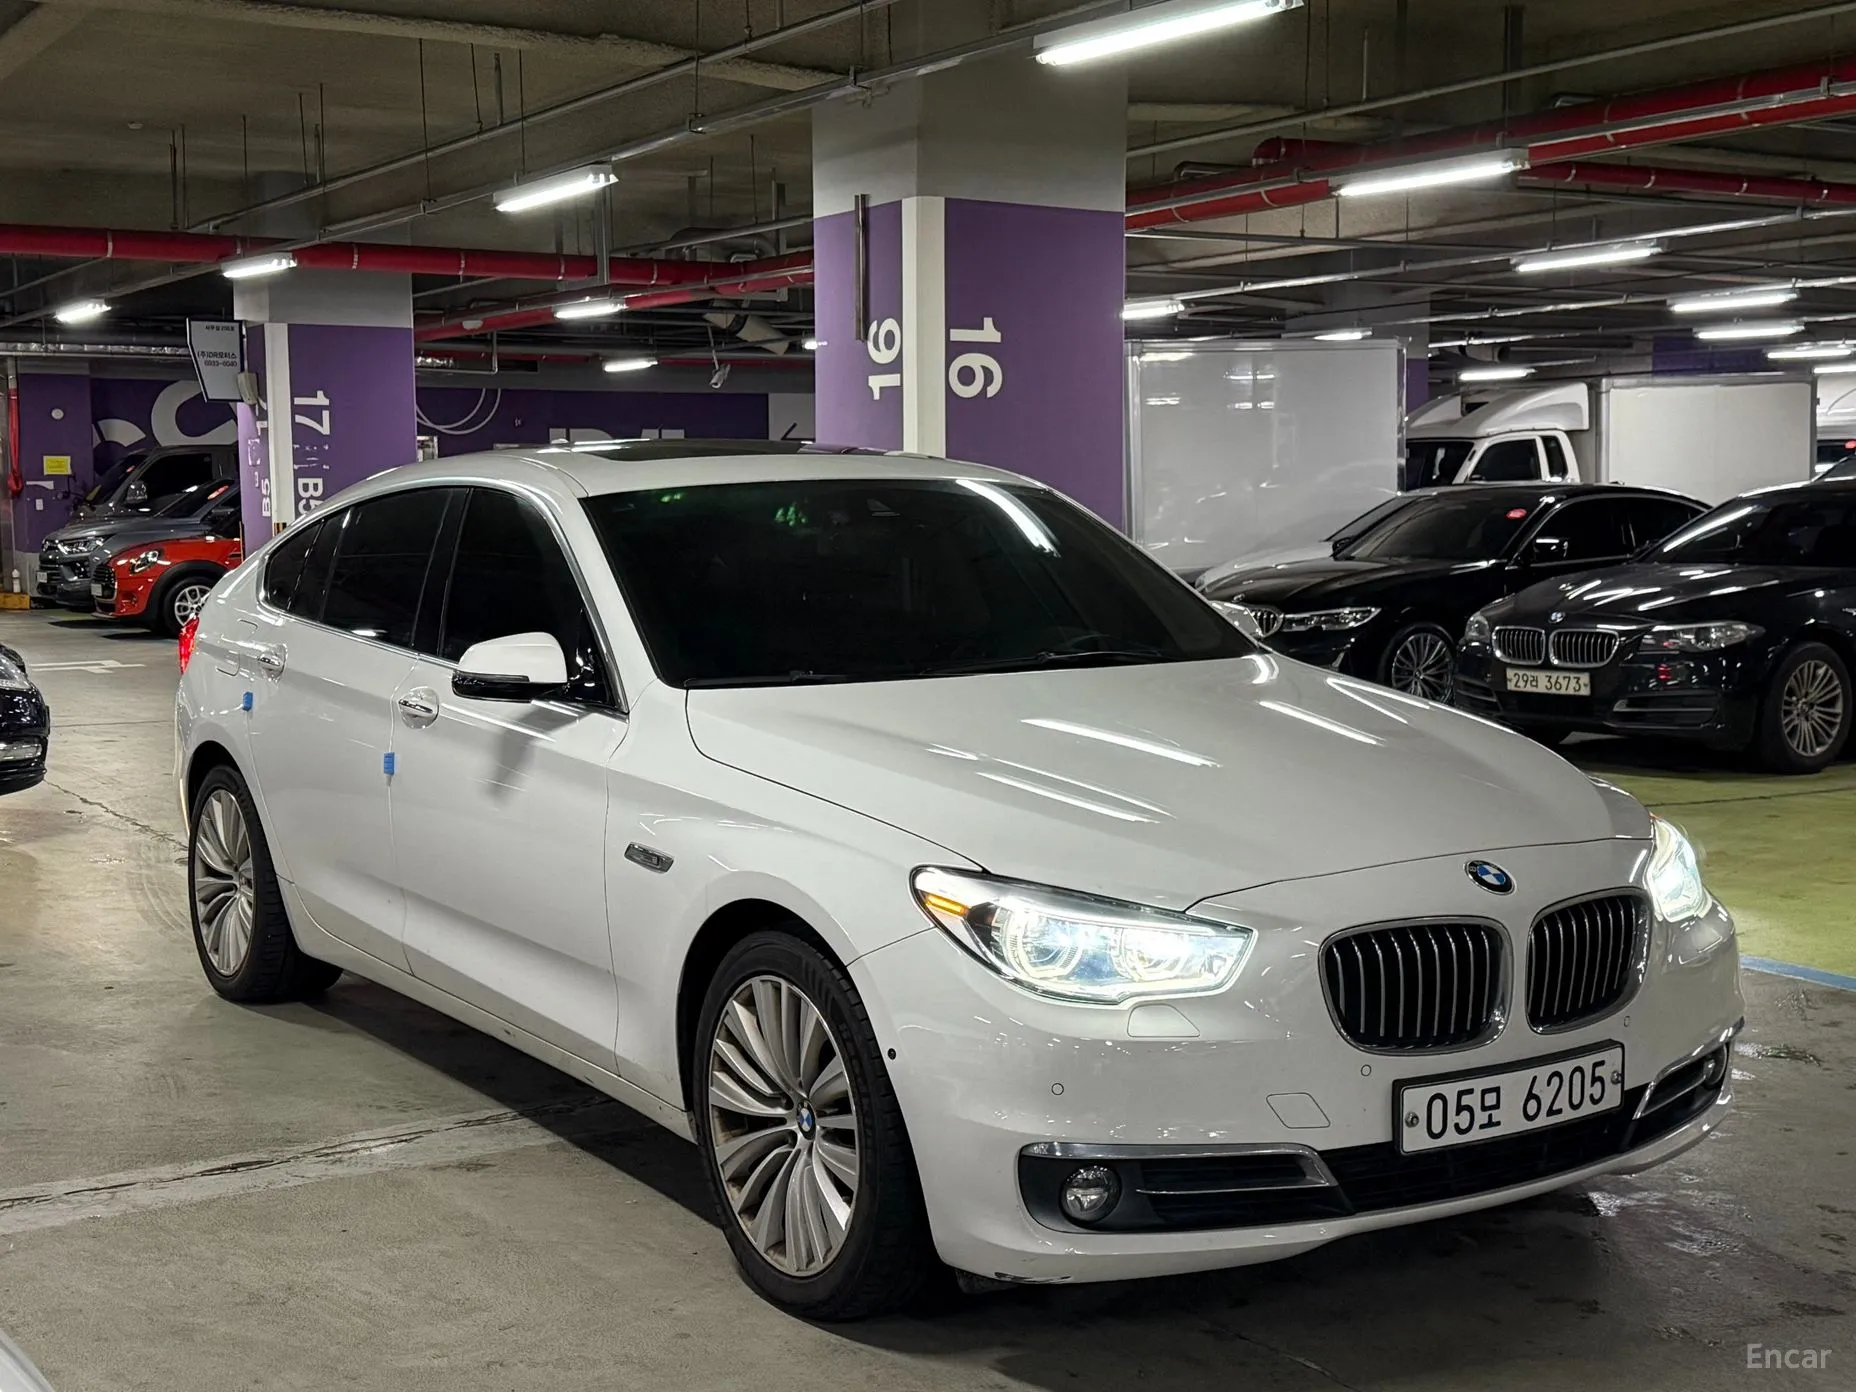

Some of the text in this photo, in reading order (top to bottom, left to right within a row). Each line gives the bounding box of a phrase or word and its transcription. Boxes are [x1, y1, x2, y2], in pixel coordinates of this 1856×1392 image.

[867, 317, 901, 400] 16
[948, 316, 1003, 399] 16
[293, 390, 331, 435] 17
[1544, 674, 1582, 692] 3673
[1425, 1060, 1606, 1140] 05모 6205
